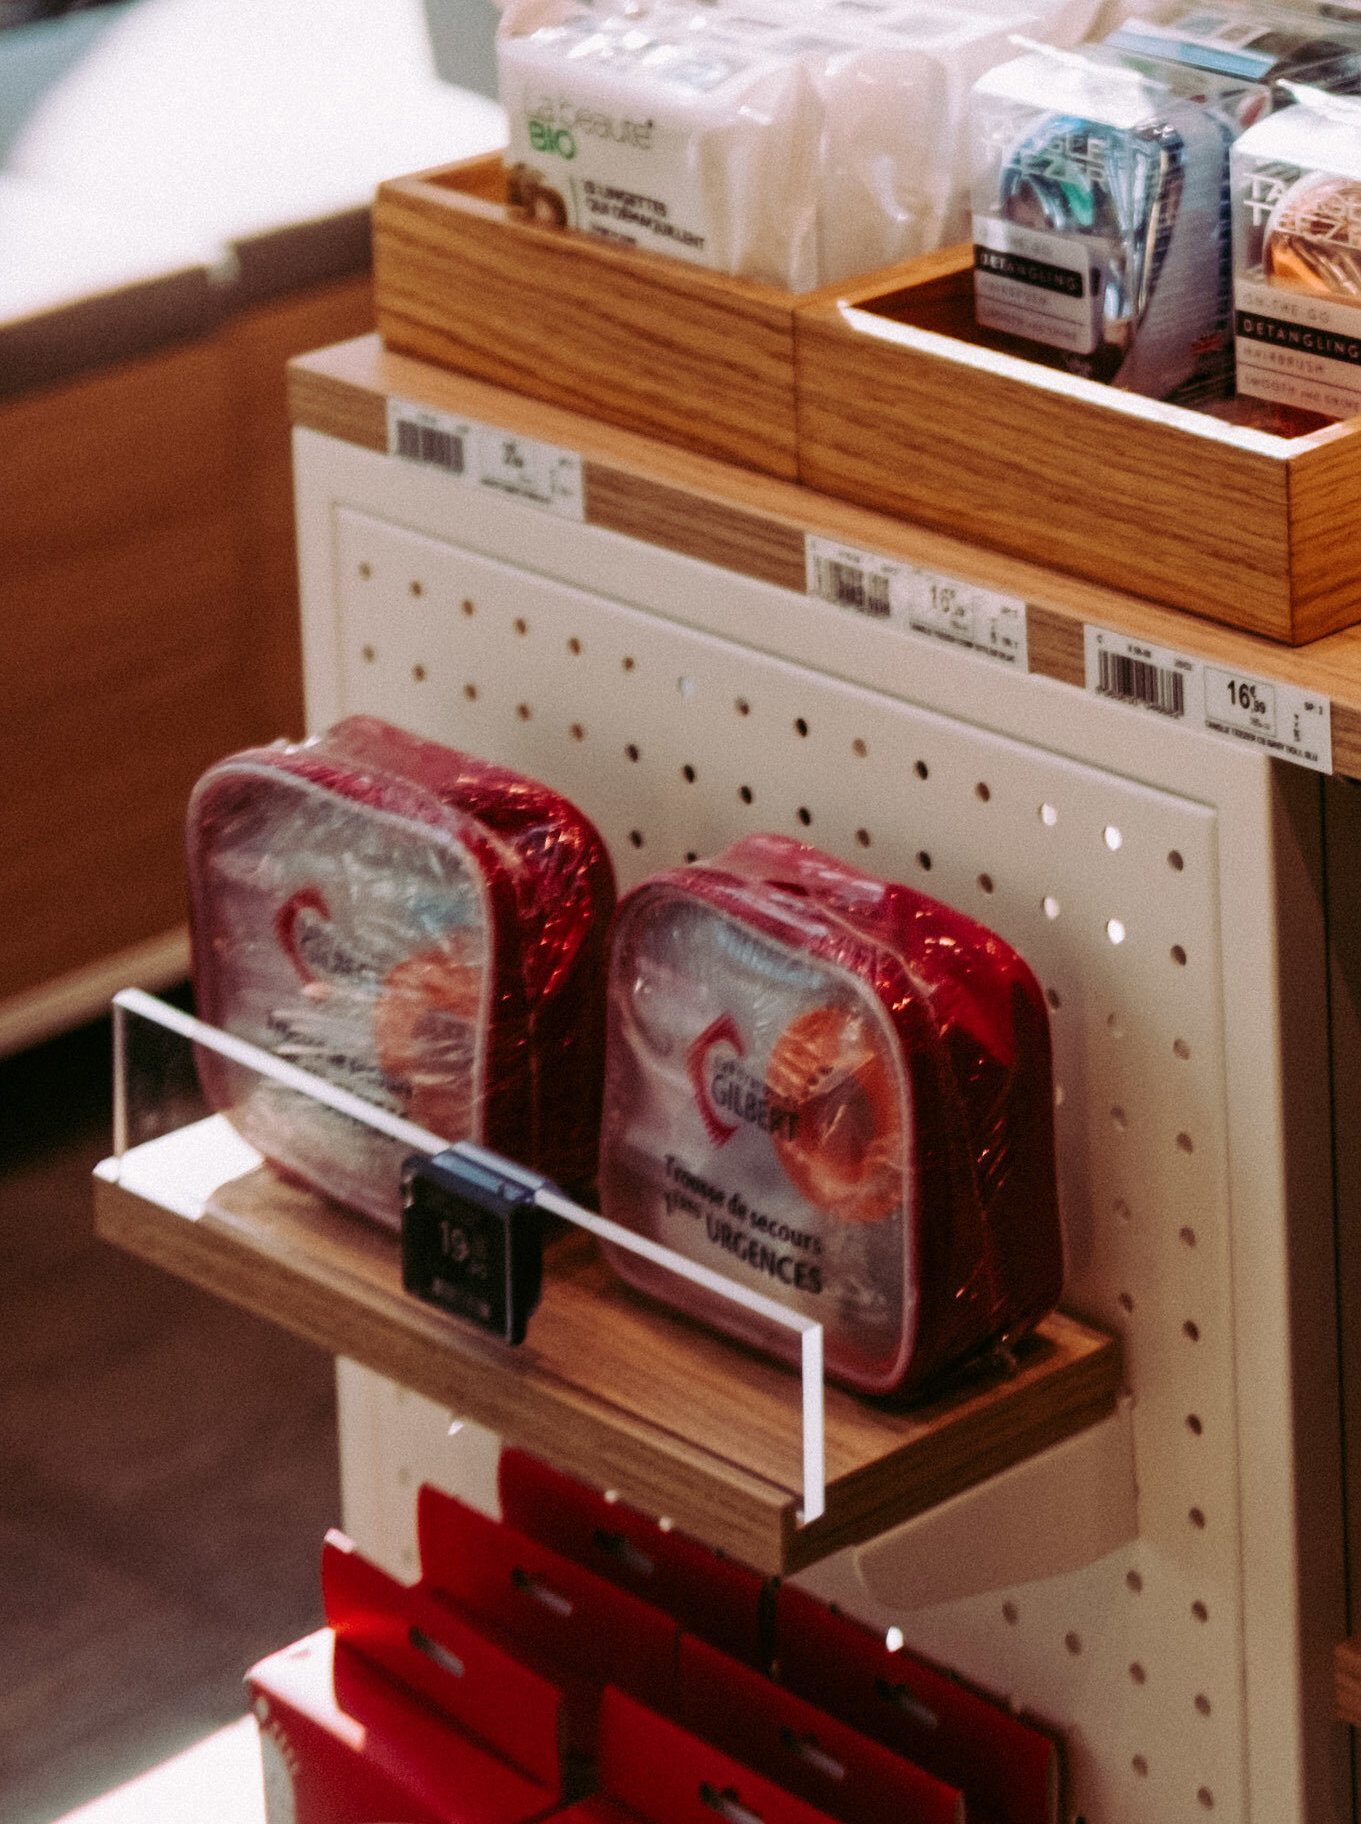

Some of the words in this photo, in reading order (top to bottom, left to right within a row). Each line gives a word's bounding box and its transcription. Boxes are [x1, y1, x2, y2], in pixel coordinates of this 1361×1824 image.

[1243, 320, 1361, 359] DETANGLING
[706, 1213, 823, 1294] URGENCES
[749, 1210, 822, 1254] secours
